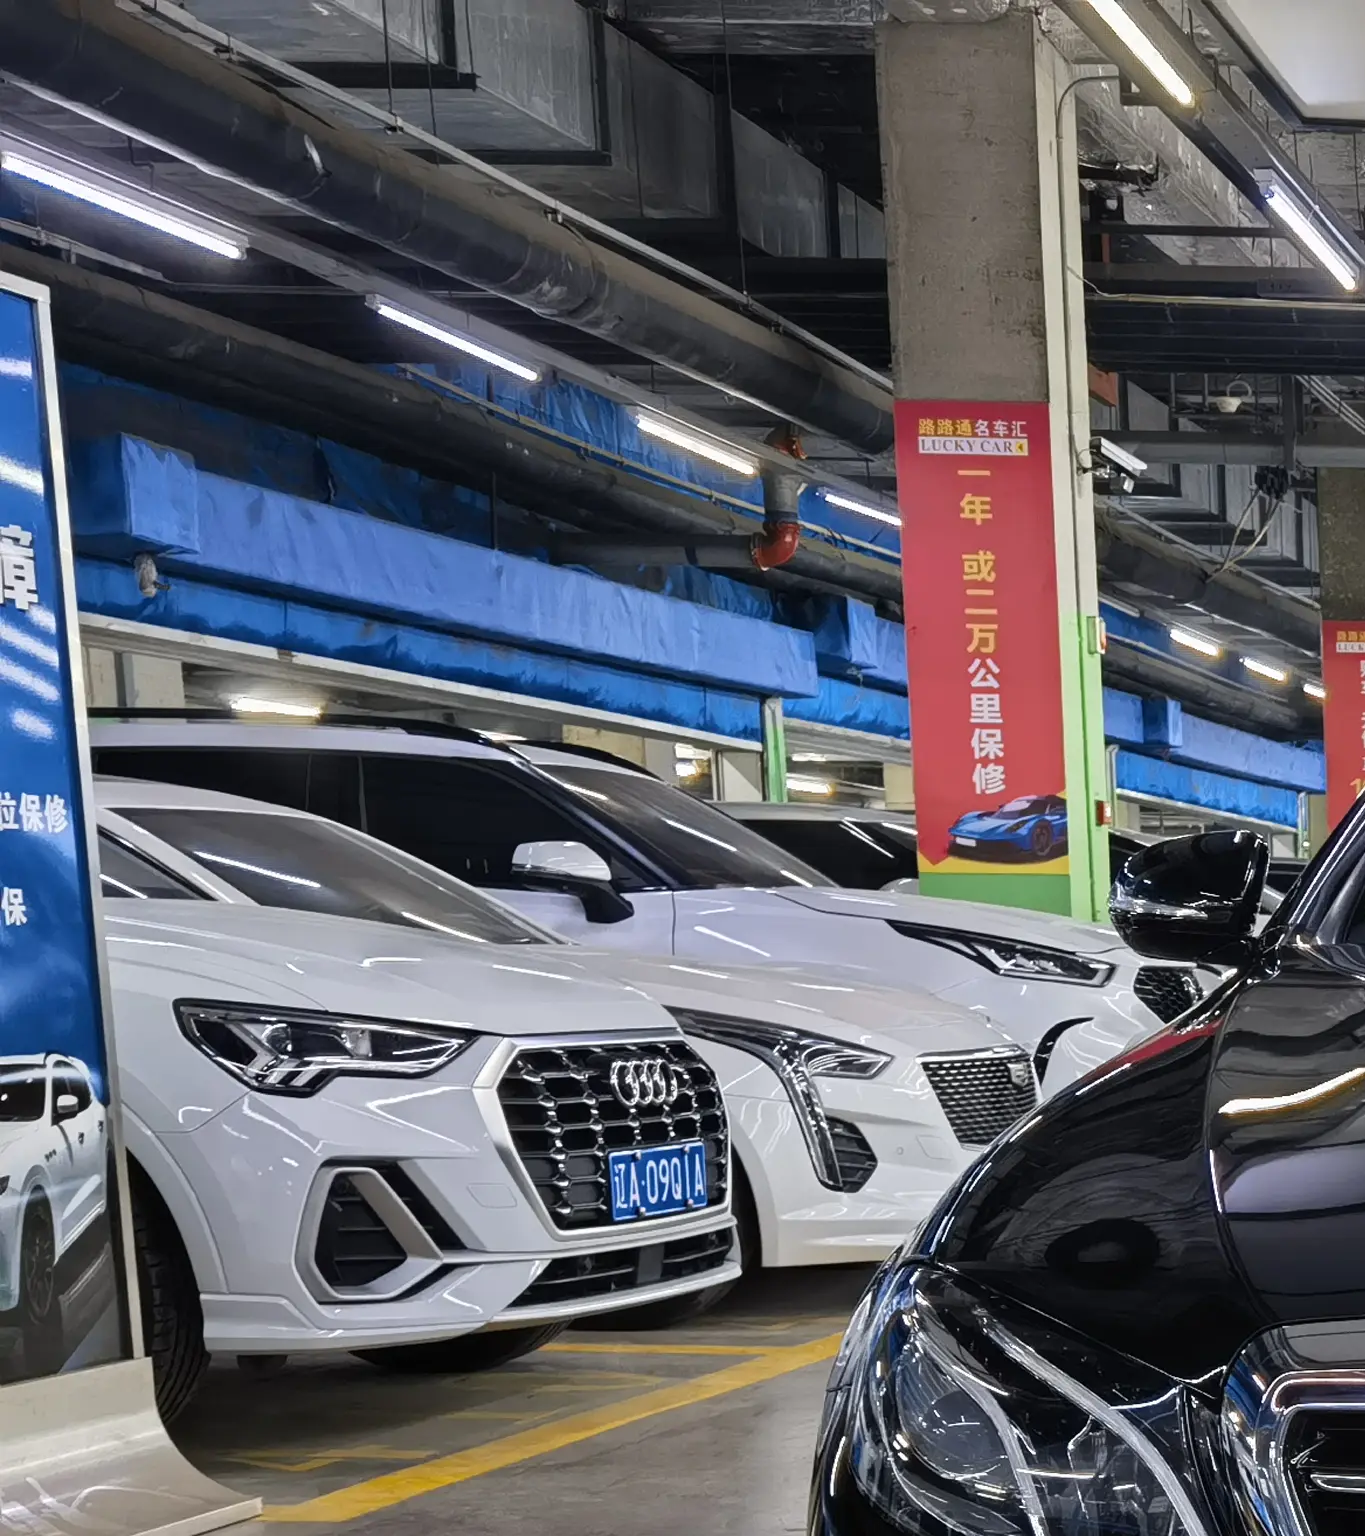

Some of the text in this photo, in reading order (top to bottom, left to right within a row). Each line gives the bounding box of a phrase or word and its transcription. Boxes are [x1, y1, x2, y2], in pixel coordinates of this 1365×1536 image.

[918, 418, 1028, 437] 路路通名车汇
[921, 439, 1013, 453] LUCKY CAR
